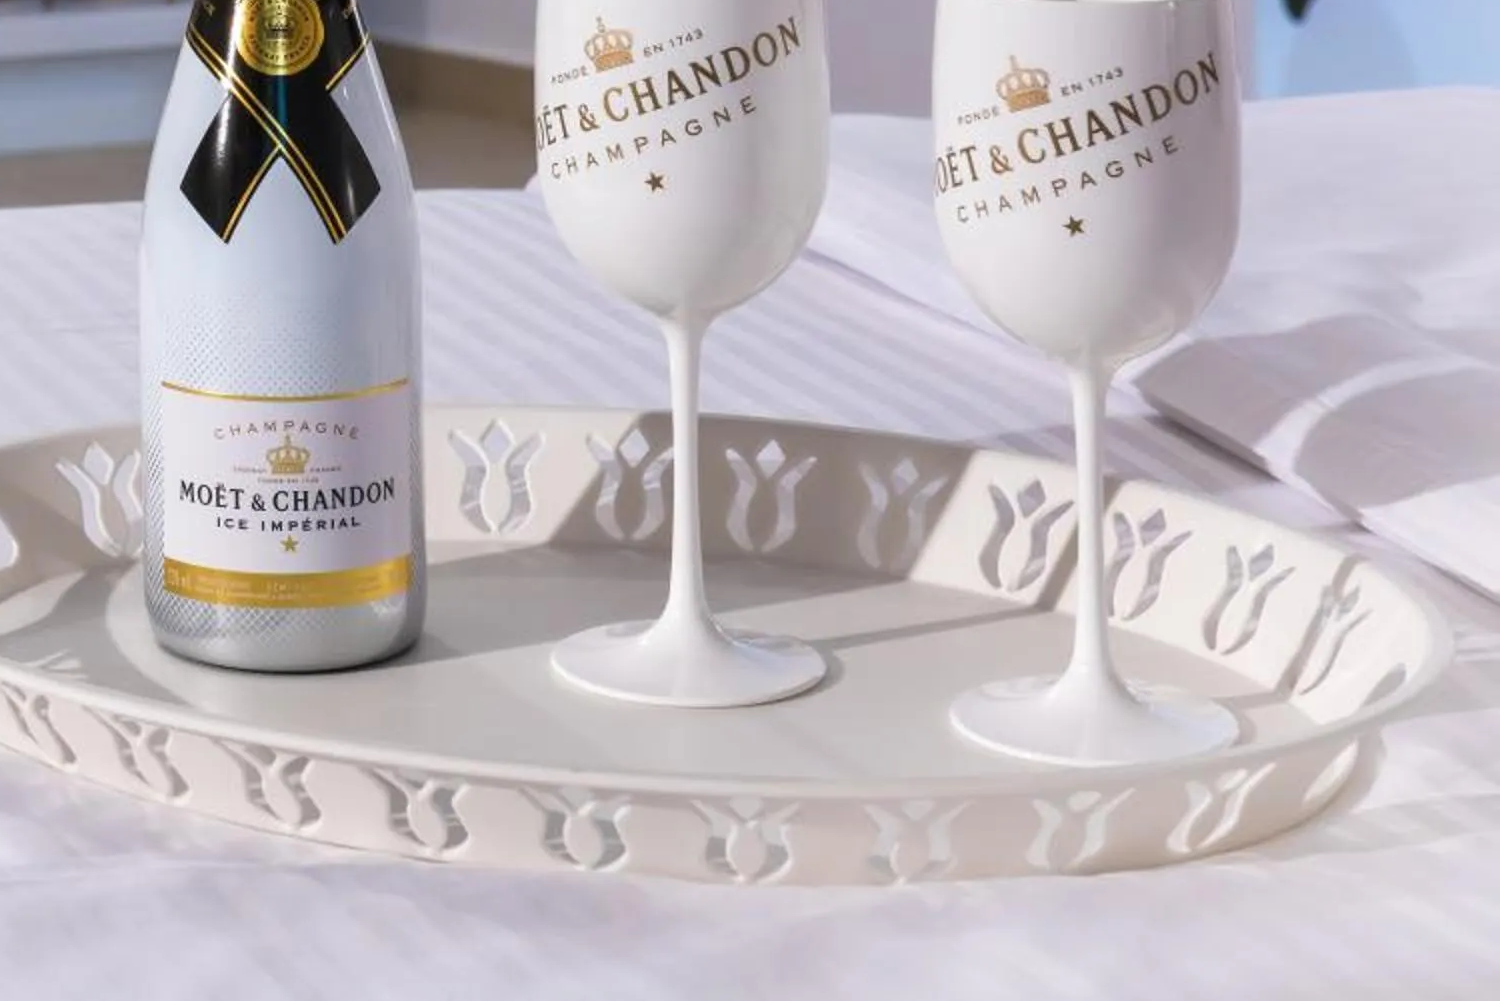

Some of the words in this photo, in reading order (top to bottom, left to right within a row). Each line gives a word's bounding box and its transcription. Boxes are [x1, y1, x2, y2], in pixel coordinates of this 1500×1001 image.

[669, 28, 703, 48] 1743
[536, 104, 569, 151] OËT
[578, 103, 600, 132] &
[603, 17, 801, 122] CHANDON
[1088, 66, 1124, 88] 1743
[551, 96, 756, 179] CHAMPAGNE
[933, 146, 978, 197] OËT
[990, 145, 1013, 174] &
[1017, 52, 1220, 164] CHANDON
[956, 135, 1179, 223] CHAMPAGNE
[213, 420, 359, 440] CHAMPAGNE
[179, 478, 244, 511] MOËT
[251, 494, 266, 511] &
[273, 477, 395, 512] CHANDON
[217, 517, 249, 531] ICE
[261, 516, 362, 532] IMPÉRIAL
